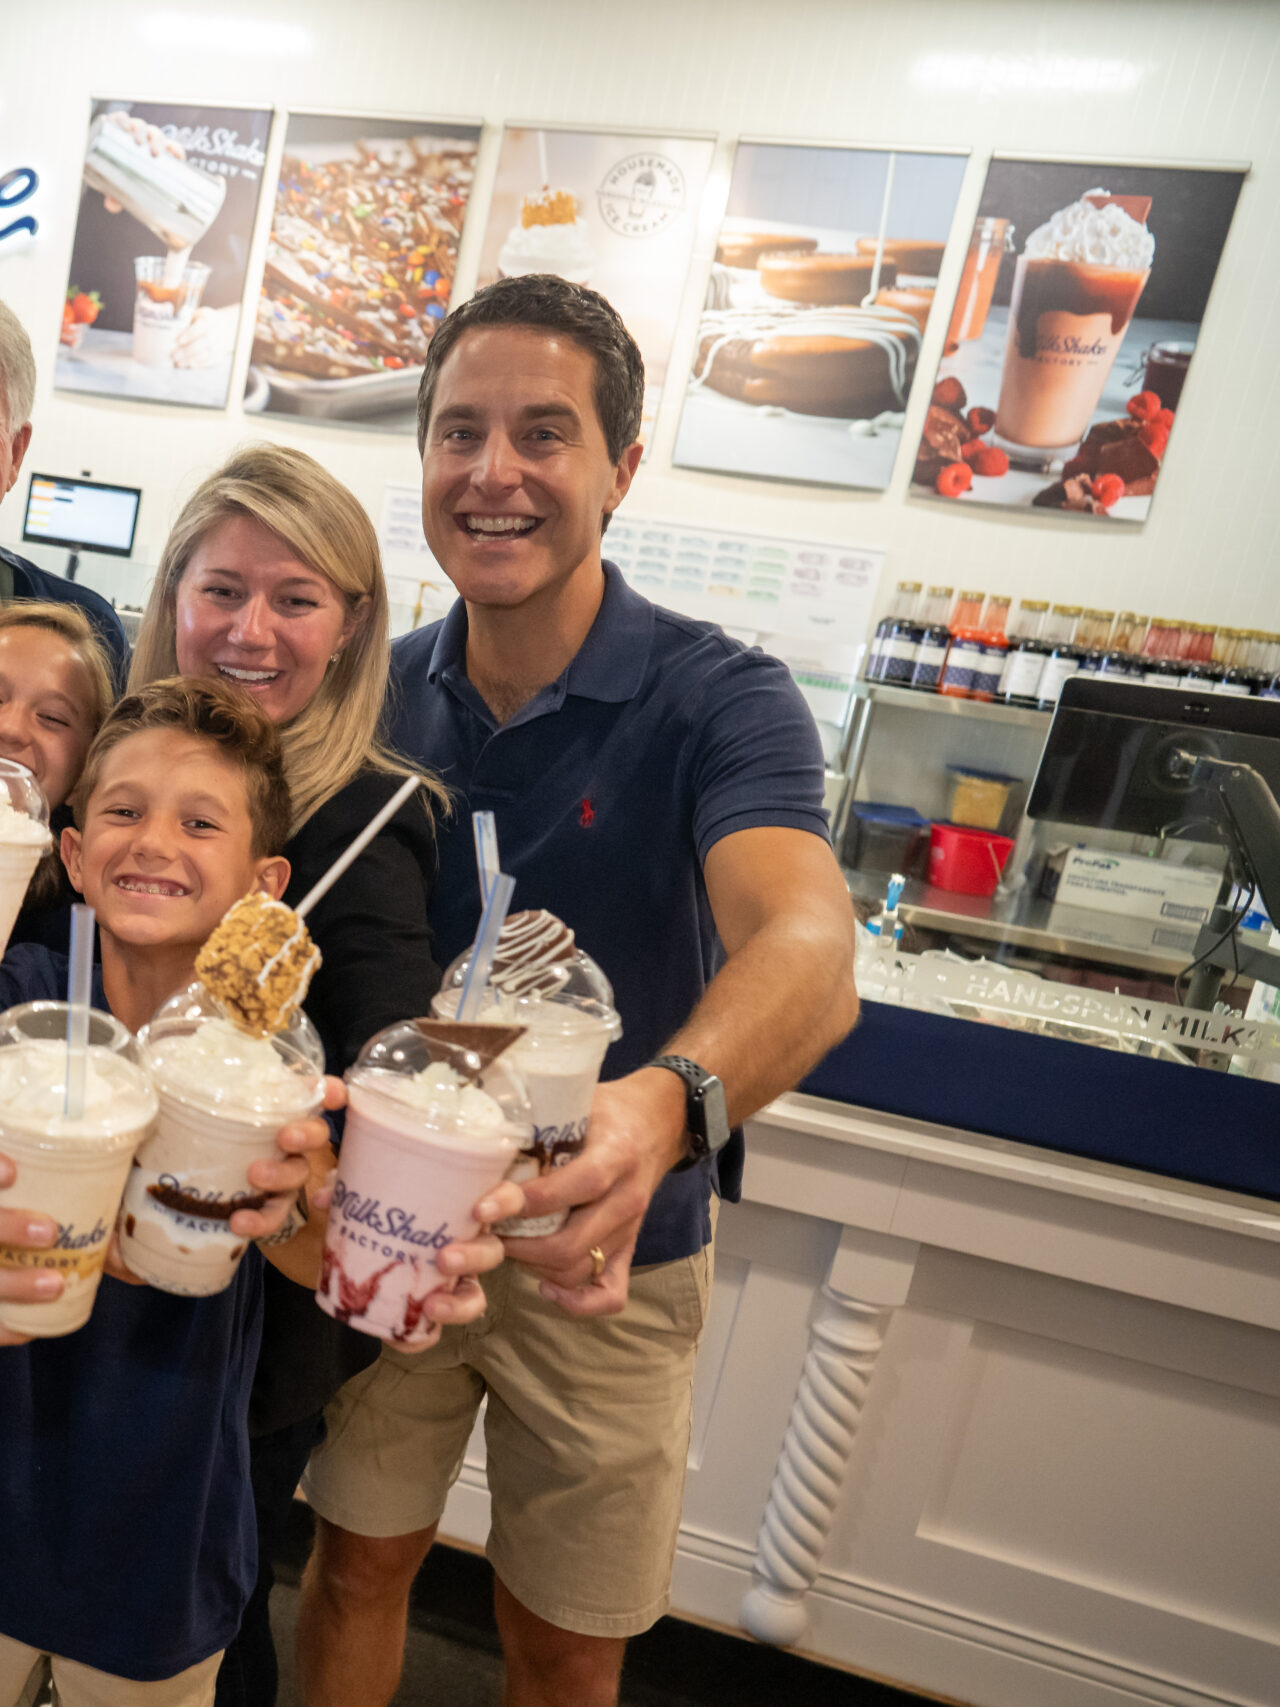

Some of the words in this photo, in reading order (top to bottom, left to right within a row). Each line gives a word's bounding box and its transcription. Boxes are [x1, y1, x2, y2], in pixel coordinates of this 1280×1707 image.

[609, 157, 681, 194] HOUSEMADE
[966, 973, 1152, 1031] HANDSPUN
[339, 1225, 419, 1266] FACTORY
